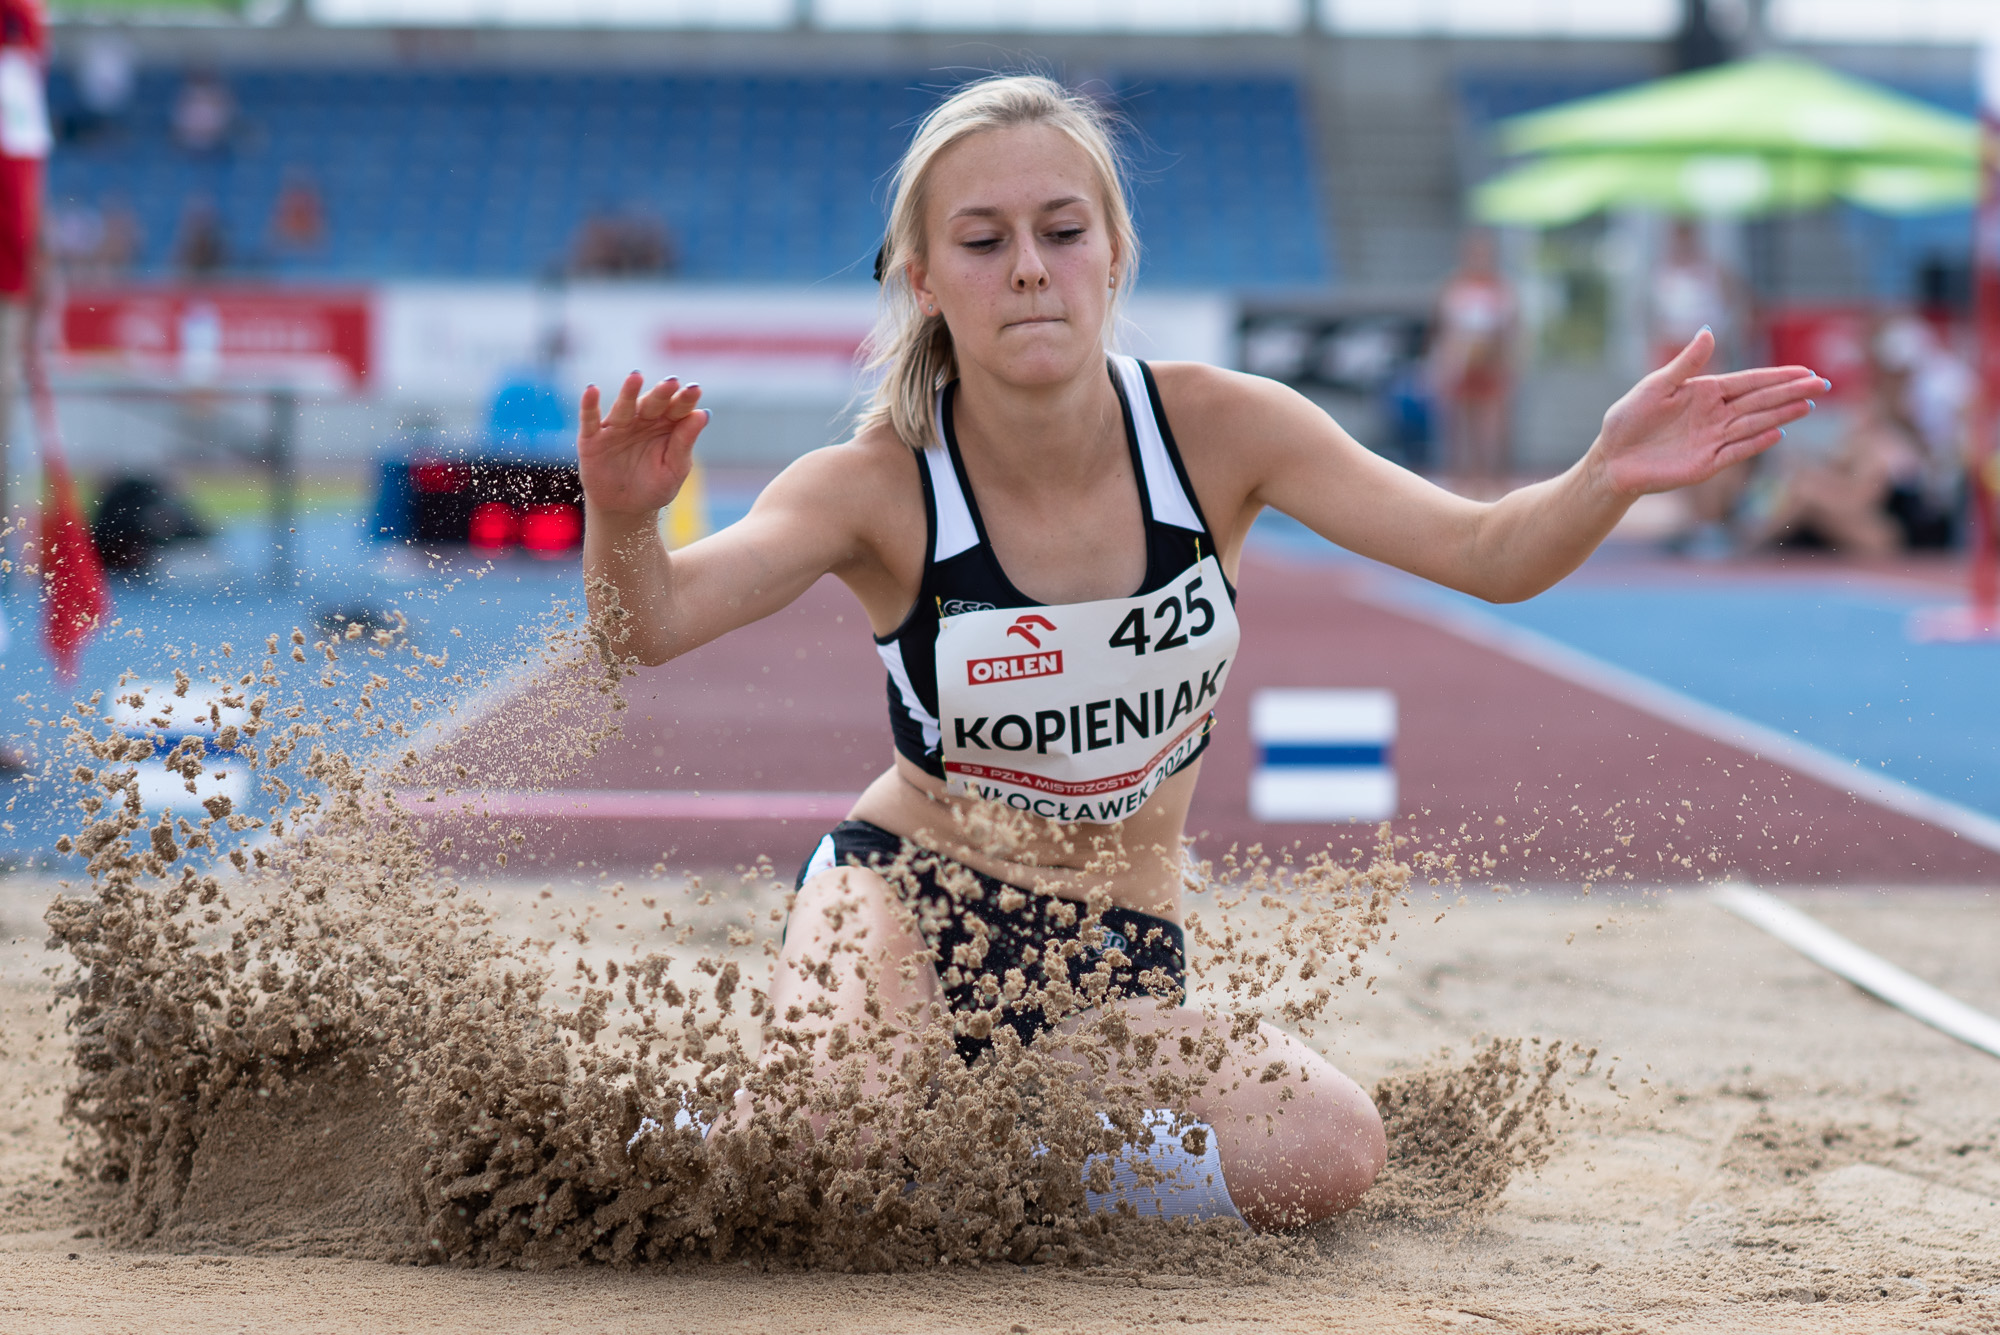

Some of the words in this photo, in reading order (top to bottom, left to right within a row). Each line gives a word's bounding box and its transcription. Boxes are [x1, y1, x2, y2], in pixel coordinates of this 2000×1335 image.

[1108, 576, 1216, 656] 425
[972, 653, 1058, 682] ORLEN
[953, 659, 1228, 755] KOPIENIAK
[960, 764, 987, 776] 53.
[990, 769, 1033, 786] PZLA
[1154, 736, 1194, 790] 2021
